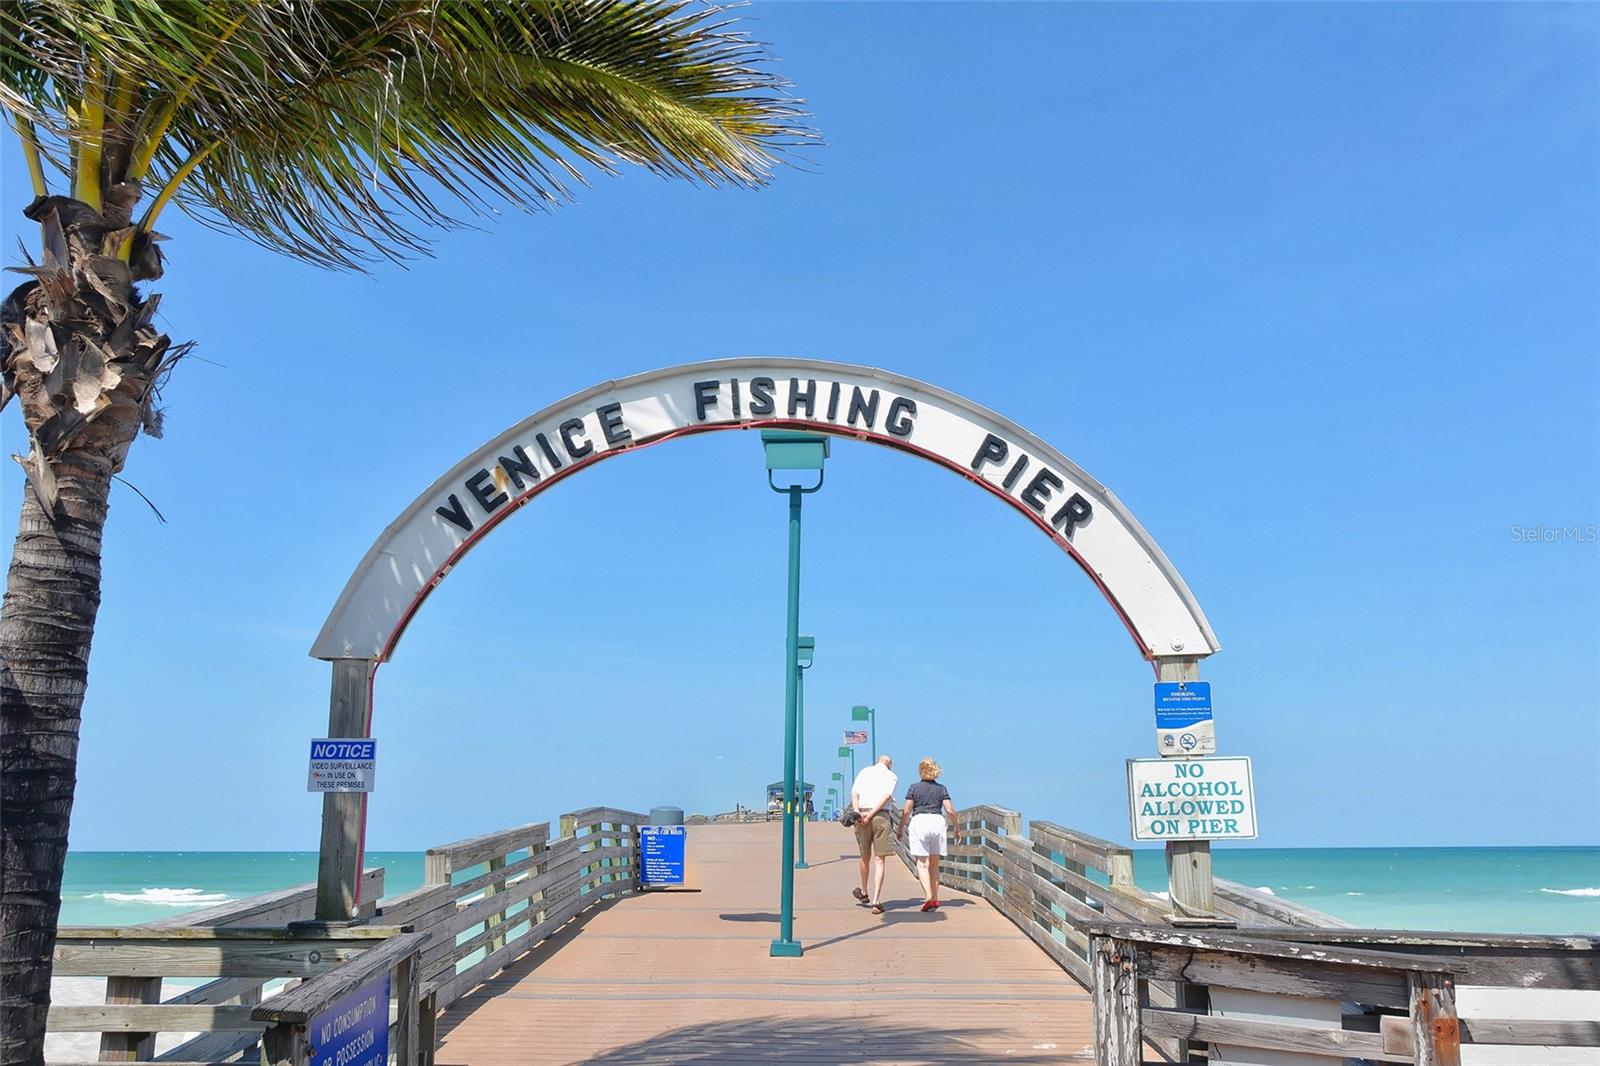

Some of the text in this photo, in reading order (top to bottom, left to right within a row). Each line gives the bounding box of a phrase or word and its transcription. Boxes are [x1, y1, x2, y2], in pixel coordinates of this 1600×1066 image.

[435, 376, 1093, 538] VENICE FISHING PIER
[313, 744, 372, 758] NOTICE
[311, 762, 373, 770] VIDEO SURVEILLANCE
[1175, 763, 1204, 778] NO
[336, 781, 365, 789] PREMISES
[1141, 781, 1243, 798] ALCOHOL
[1141, 800, 1245, 816] ALLOWED
[1150, 819, 1240, 835] ON PIER
[321, 994, 377, 1046] NO CONSUMPTION
[336, 1027, 375, 1066] POSSESSION
